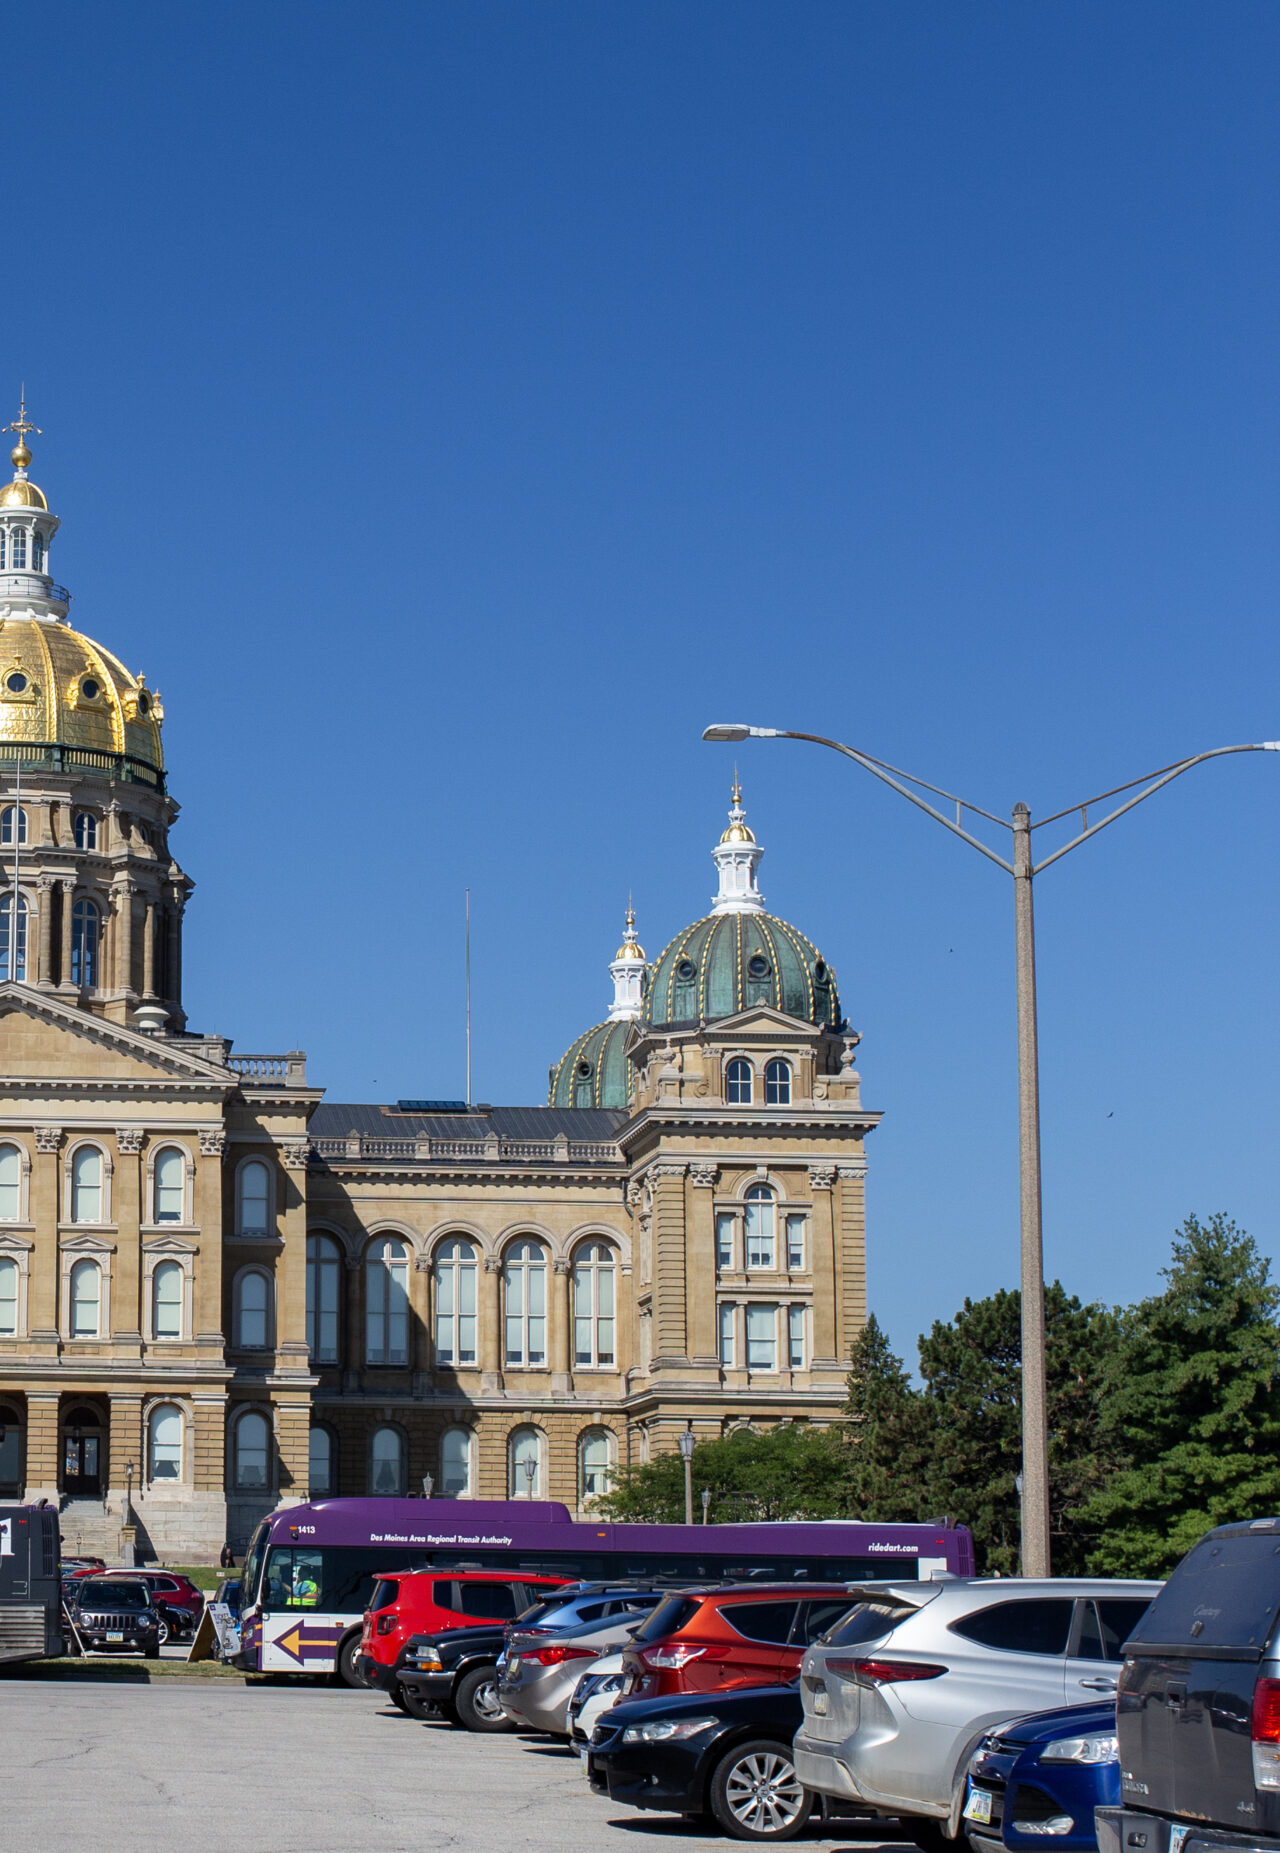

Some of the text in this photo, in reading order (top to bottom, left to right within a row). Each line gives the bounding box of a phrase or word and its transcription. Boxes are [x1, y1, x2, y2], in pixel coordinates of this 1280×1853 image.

[297, 1525, 316, 1534] 1413
[370, 1533, 513, 1546] Des Moines Area Regional Transit Authority
[868, 1542, 919, 1553] ridedart.com
